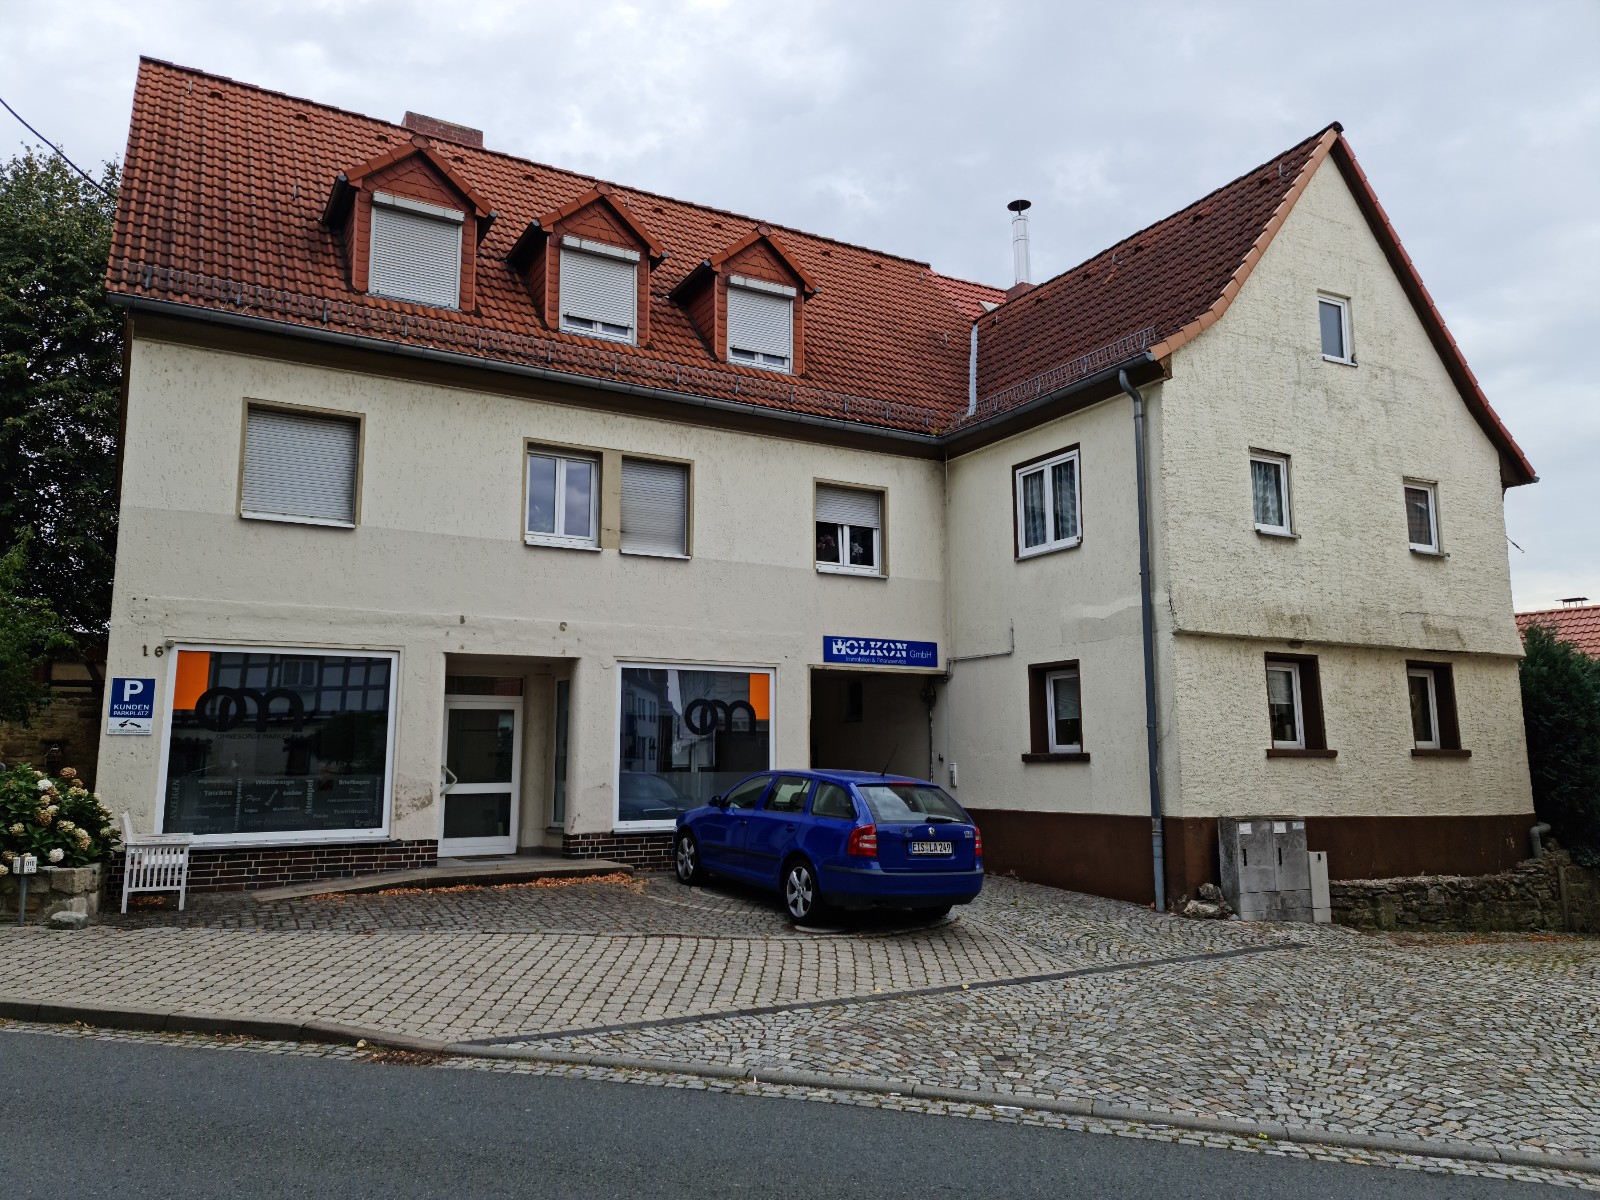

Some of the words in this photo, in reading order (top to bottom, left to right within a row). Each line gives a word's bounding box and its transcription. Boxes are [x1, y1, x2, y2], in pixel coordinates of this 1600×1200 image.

[909, 649, 932, 659] GmbH
[123, 679, 144, 702] P
[113, 703, 150, 711] KUNDEN
[304, 779, 315, 815] Stempel
[912, 842, 925, 852] EIS
[929, 842, 938, 852] LA
[938, 842, 951, 852] 249
